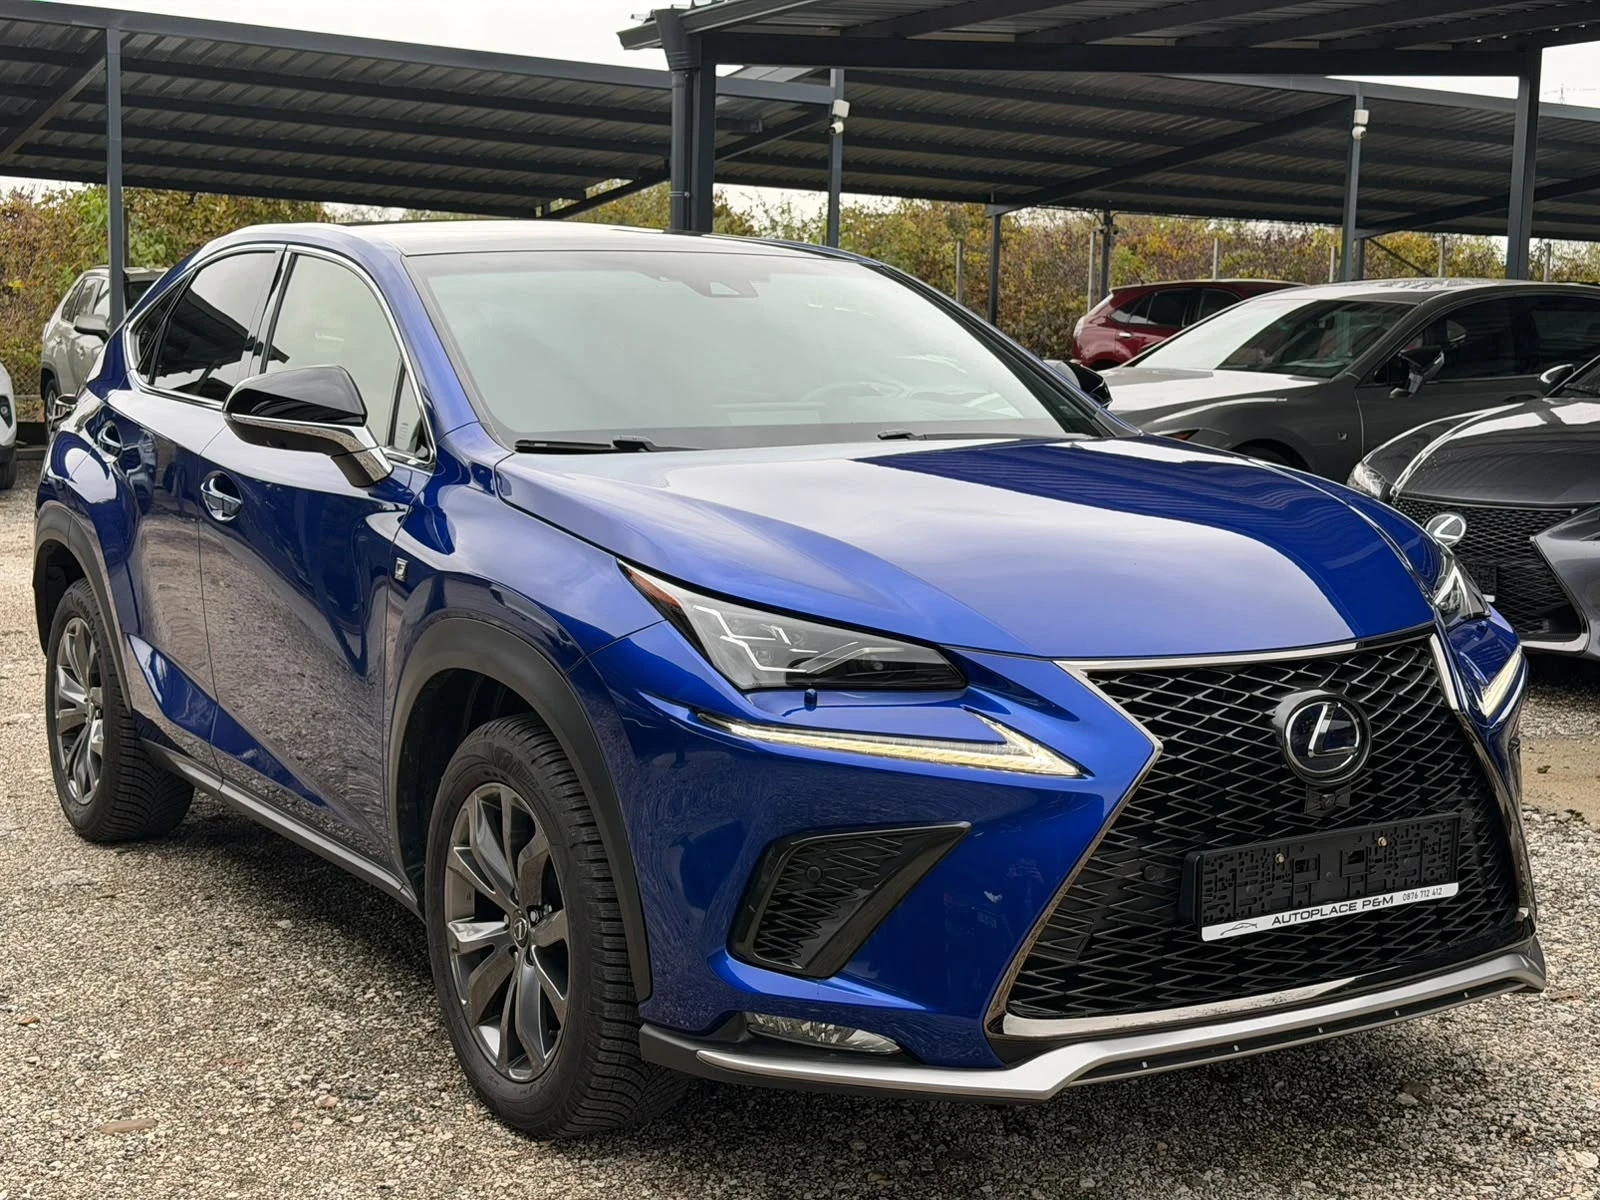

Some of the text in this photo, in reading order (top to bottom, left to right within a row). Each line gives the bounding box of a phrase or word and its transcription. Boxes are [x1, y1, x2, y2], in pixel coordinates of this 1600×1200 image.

[1271, 887, 1443, 926] AUTOPLACE P&M 0876 712 412
